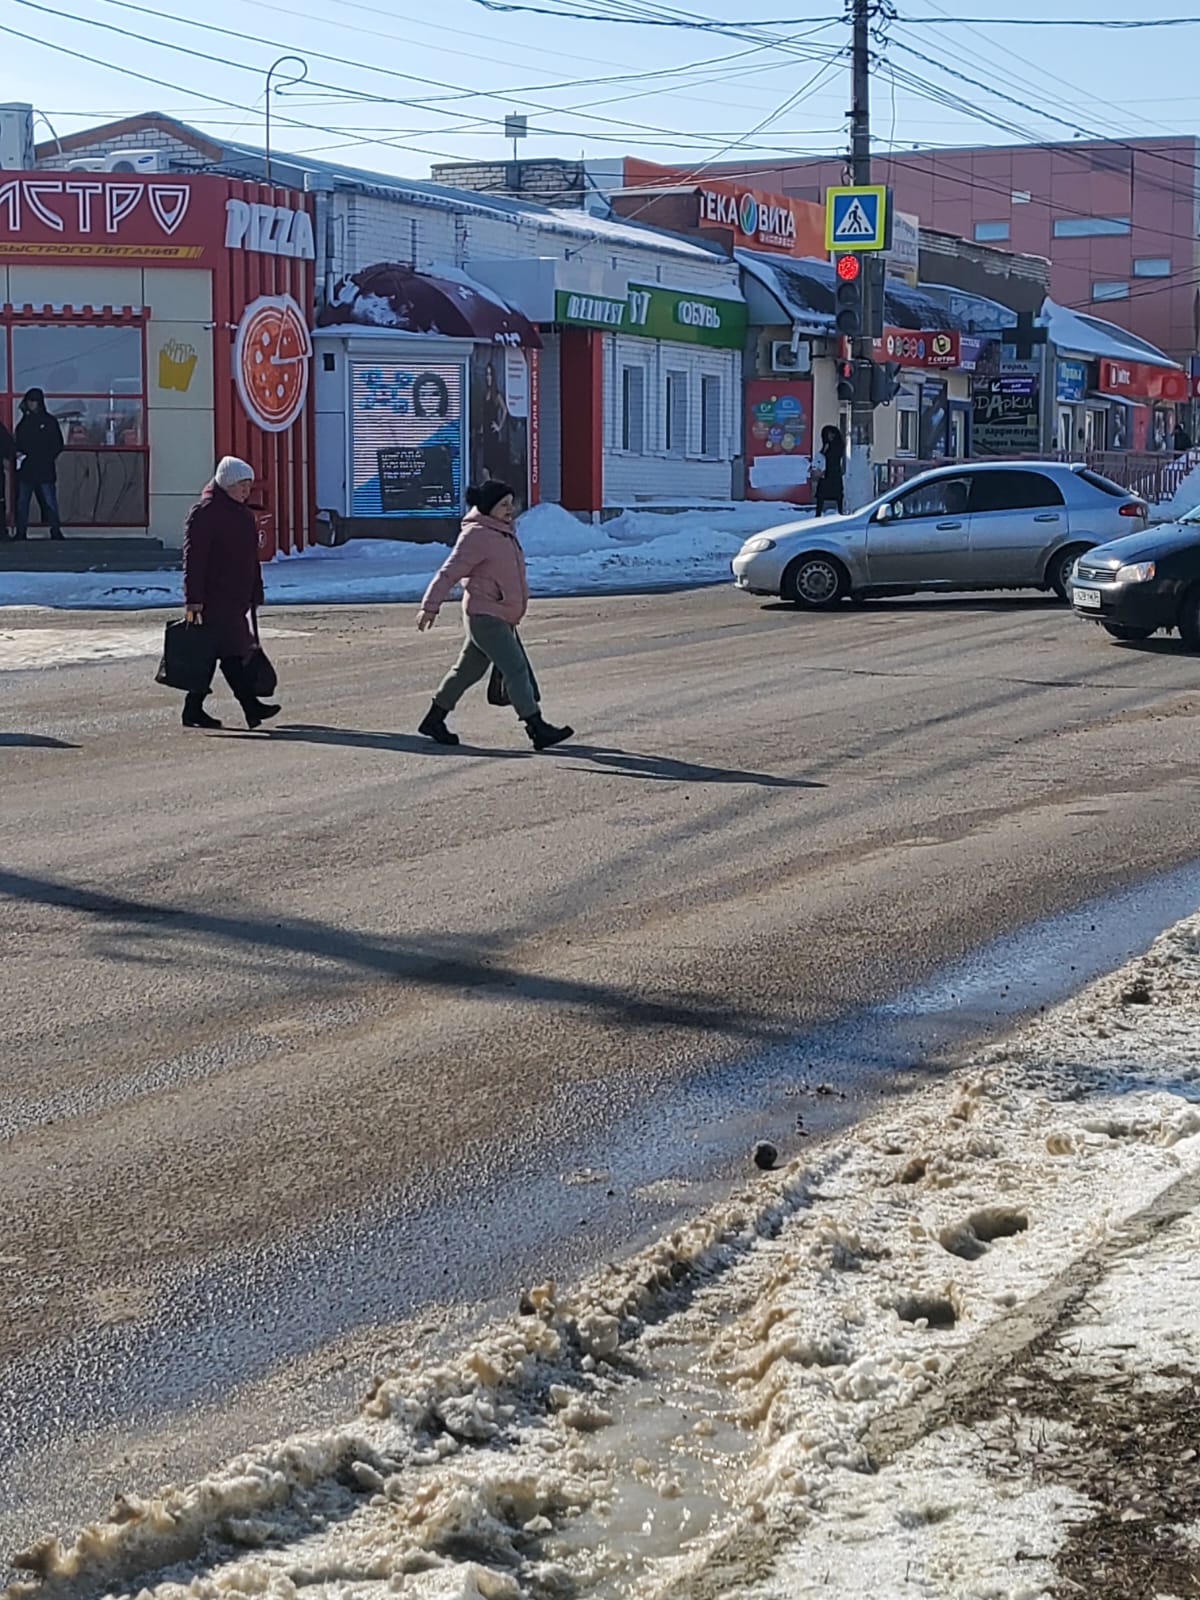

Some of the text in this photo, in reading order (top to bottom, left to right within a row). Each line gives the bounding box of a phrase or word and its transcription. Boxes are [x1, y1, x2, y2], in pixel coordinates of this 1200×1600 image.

[224, 198, 316, 260] PIZZA
[758, 203, 797, 239] ВИТА
[95, 246, 180, 256] ПИТАНИЯ
[677, 300, 721, 329] ОБУВЬ
